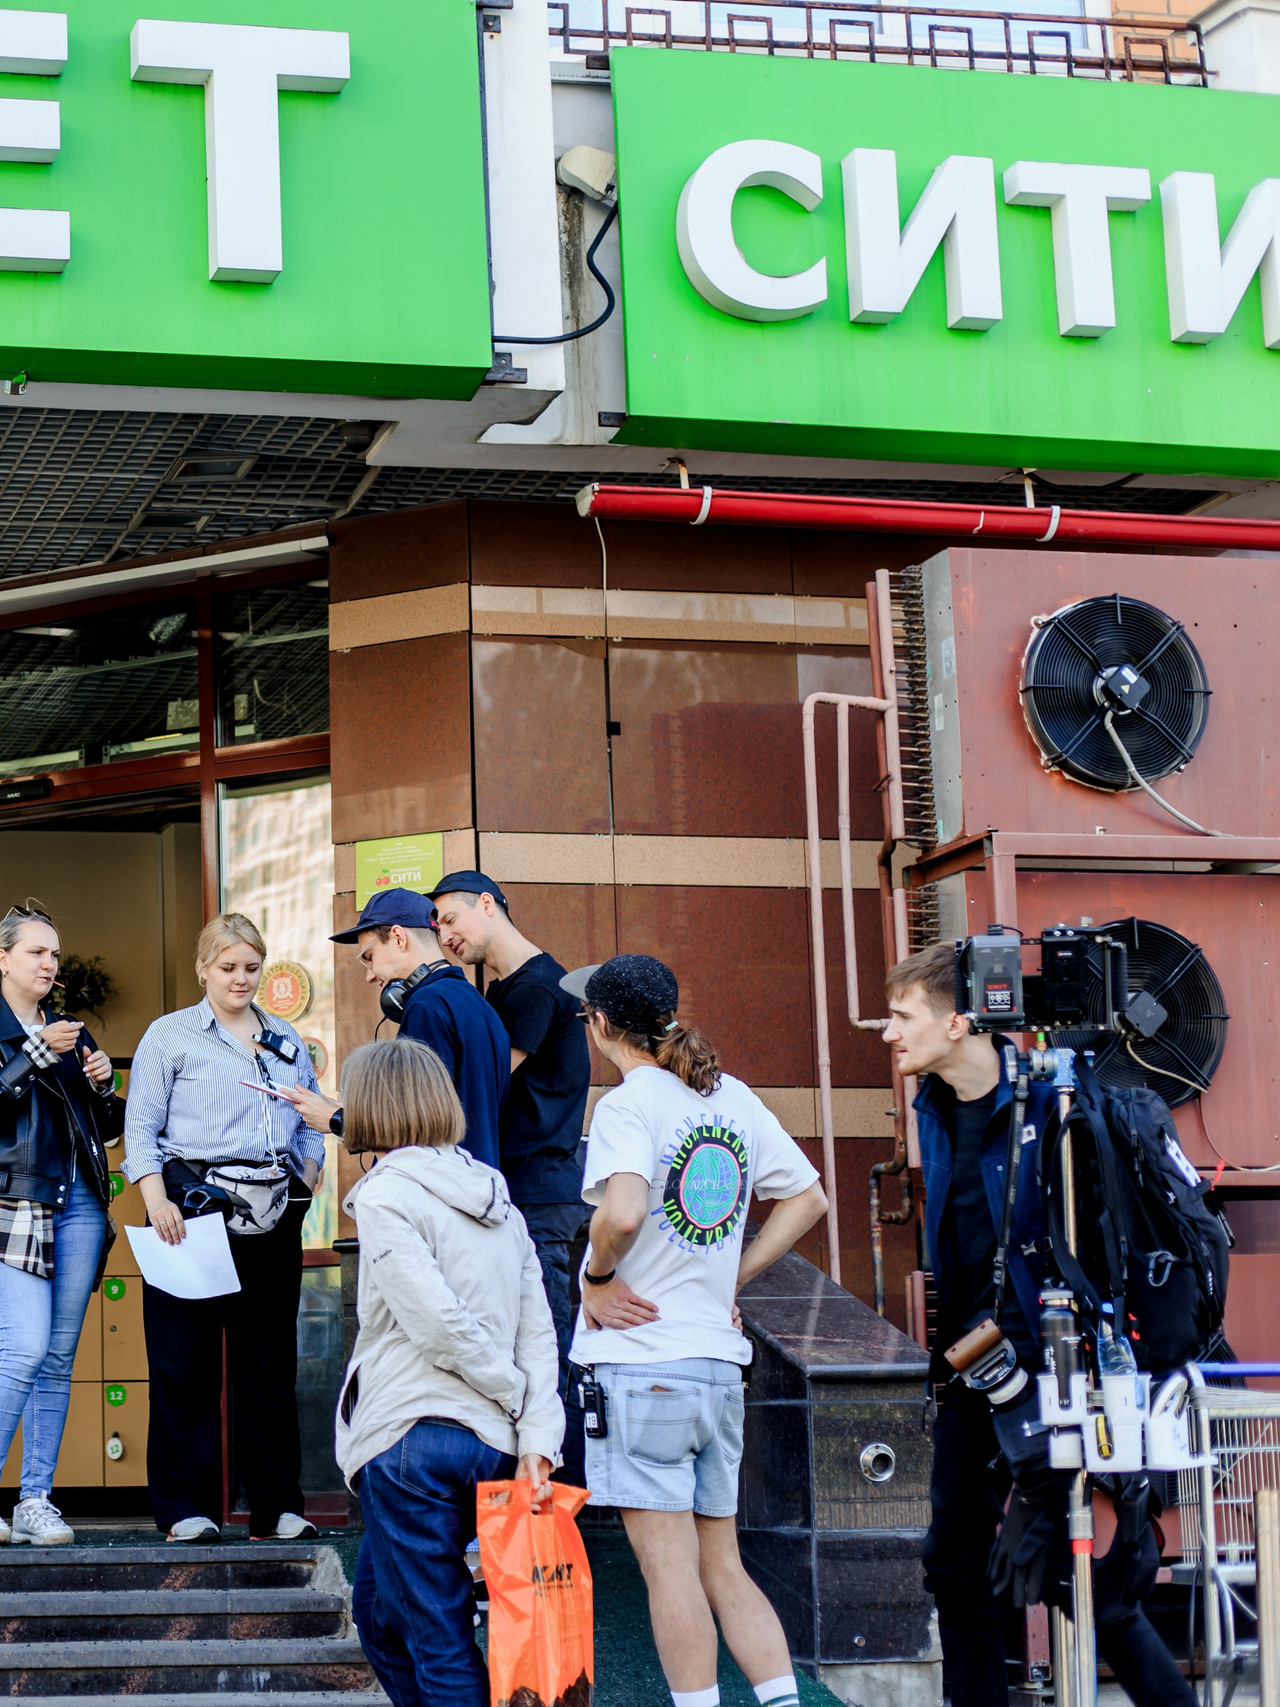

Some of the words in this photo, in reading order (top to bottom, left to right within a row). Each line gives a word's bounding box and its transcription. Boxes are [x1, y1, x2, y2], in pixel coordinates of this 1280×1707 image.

[676, 139, 1280, 350] СИТИ
[390, 871, 422, 884] СИТИ
[111, 1285, 119, 1295] 9
[109, 1391, 123, 1401] 12
[587, 1415, 596, 1426] 19
[110, 1444, 120, 1455] 12
